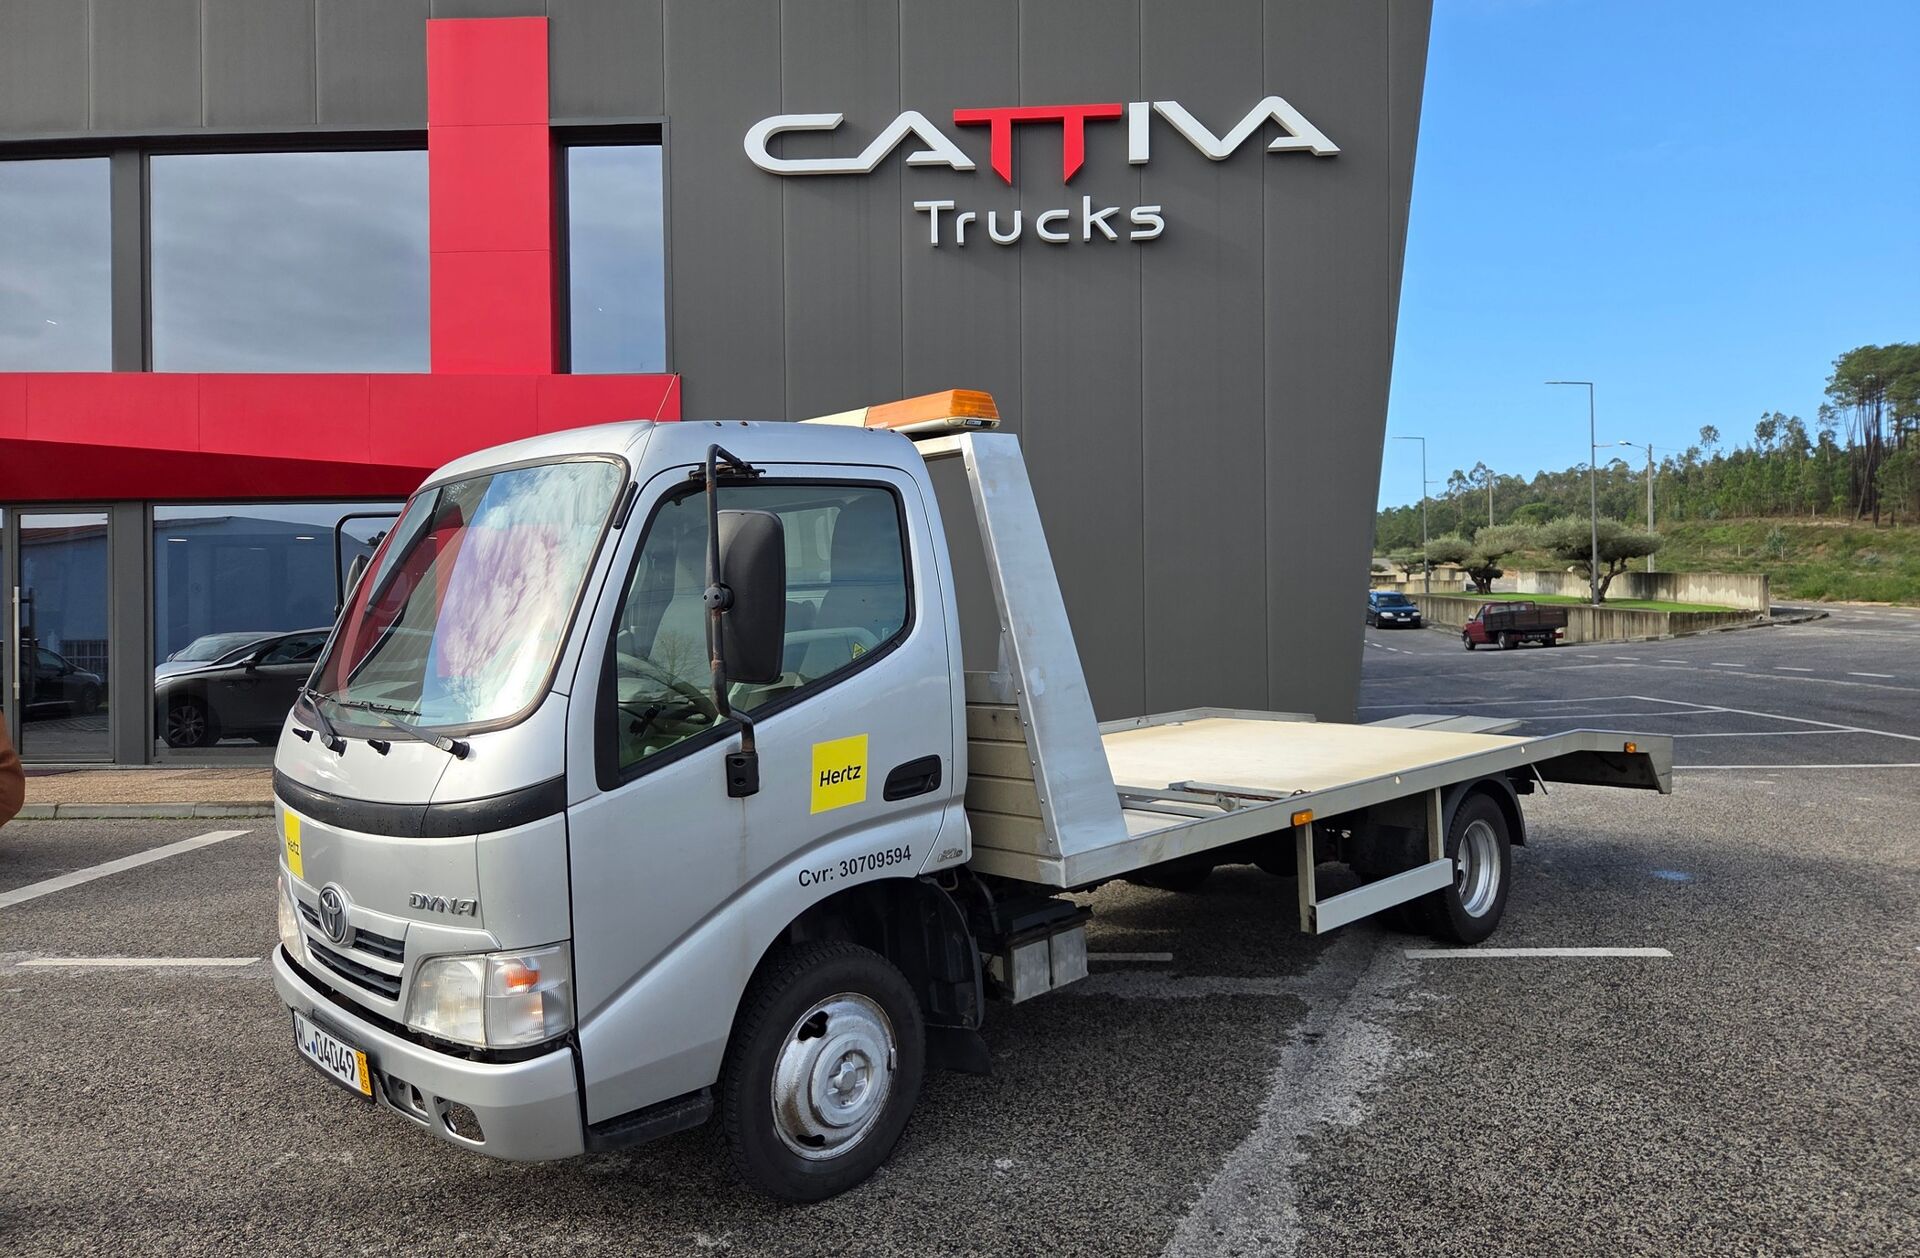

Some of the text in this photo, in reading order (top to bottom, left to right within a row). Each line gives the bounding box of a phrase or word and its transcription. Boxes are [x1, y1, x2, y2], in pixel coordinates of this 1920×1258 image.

[744, 96, 1341, 186] CATTIVA
[914, 196, 1165, 247] Trucks
[819, 765, 862, 787] Hertz
[798, 867, 835, 887] Cvr:
[839, 845, 912, 877] 30709594
[408, 891, 478, 917] DYNA
[314, 1030, 356, 1082] 04049
